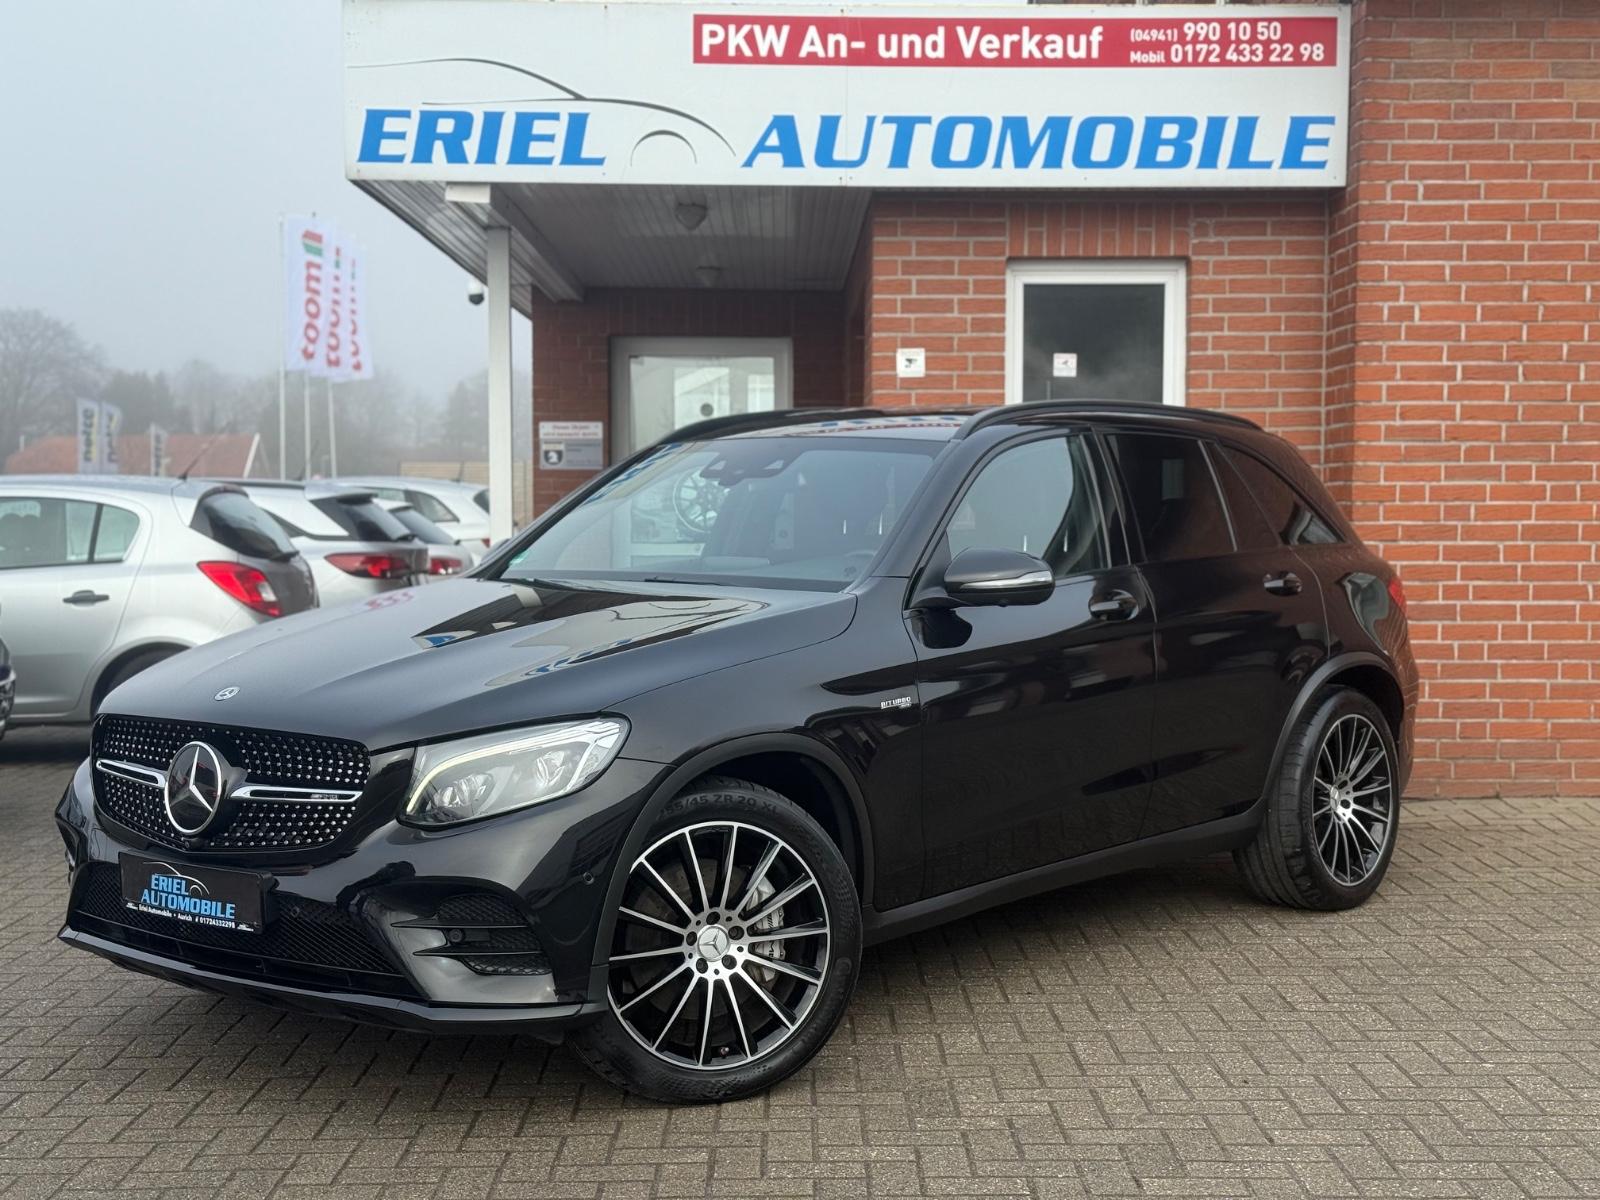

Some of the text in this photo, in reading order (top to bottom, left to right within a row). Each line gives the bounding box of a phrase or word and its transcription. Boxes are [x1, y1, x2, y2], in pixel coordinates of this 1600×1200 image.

[701, 23, 1103, 59] PKW An- und Verkauf
[1130, 21, 1281, 42] (04941) 990 10 50
[1130, 43, 1324, 63] Mobil 0172 433 22 98
[357, 108, 1336, 169] ERIEL AUTOMOBILE
[301, 261, 322, 361] toom
[151, 874, 189, 895] ERIEL
[141, 888, 236, 918] AUTOMOBILE
